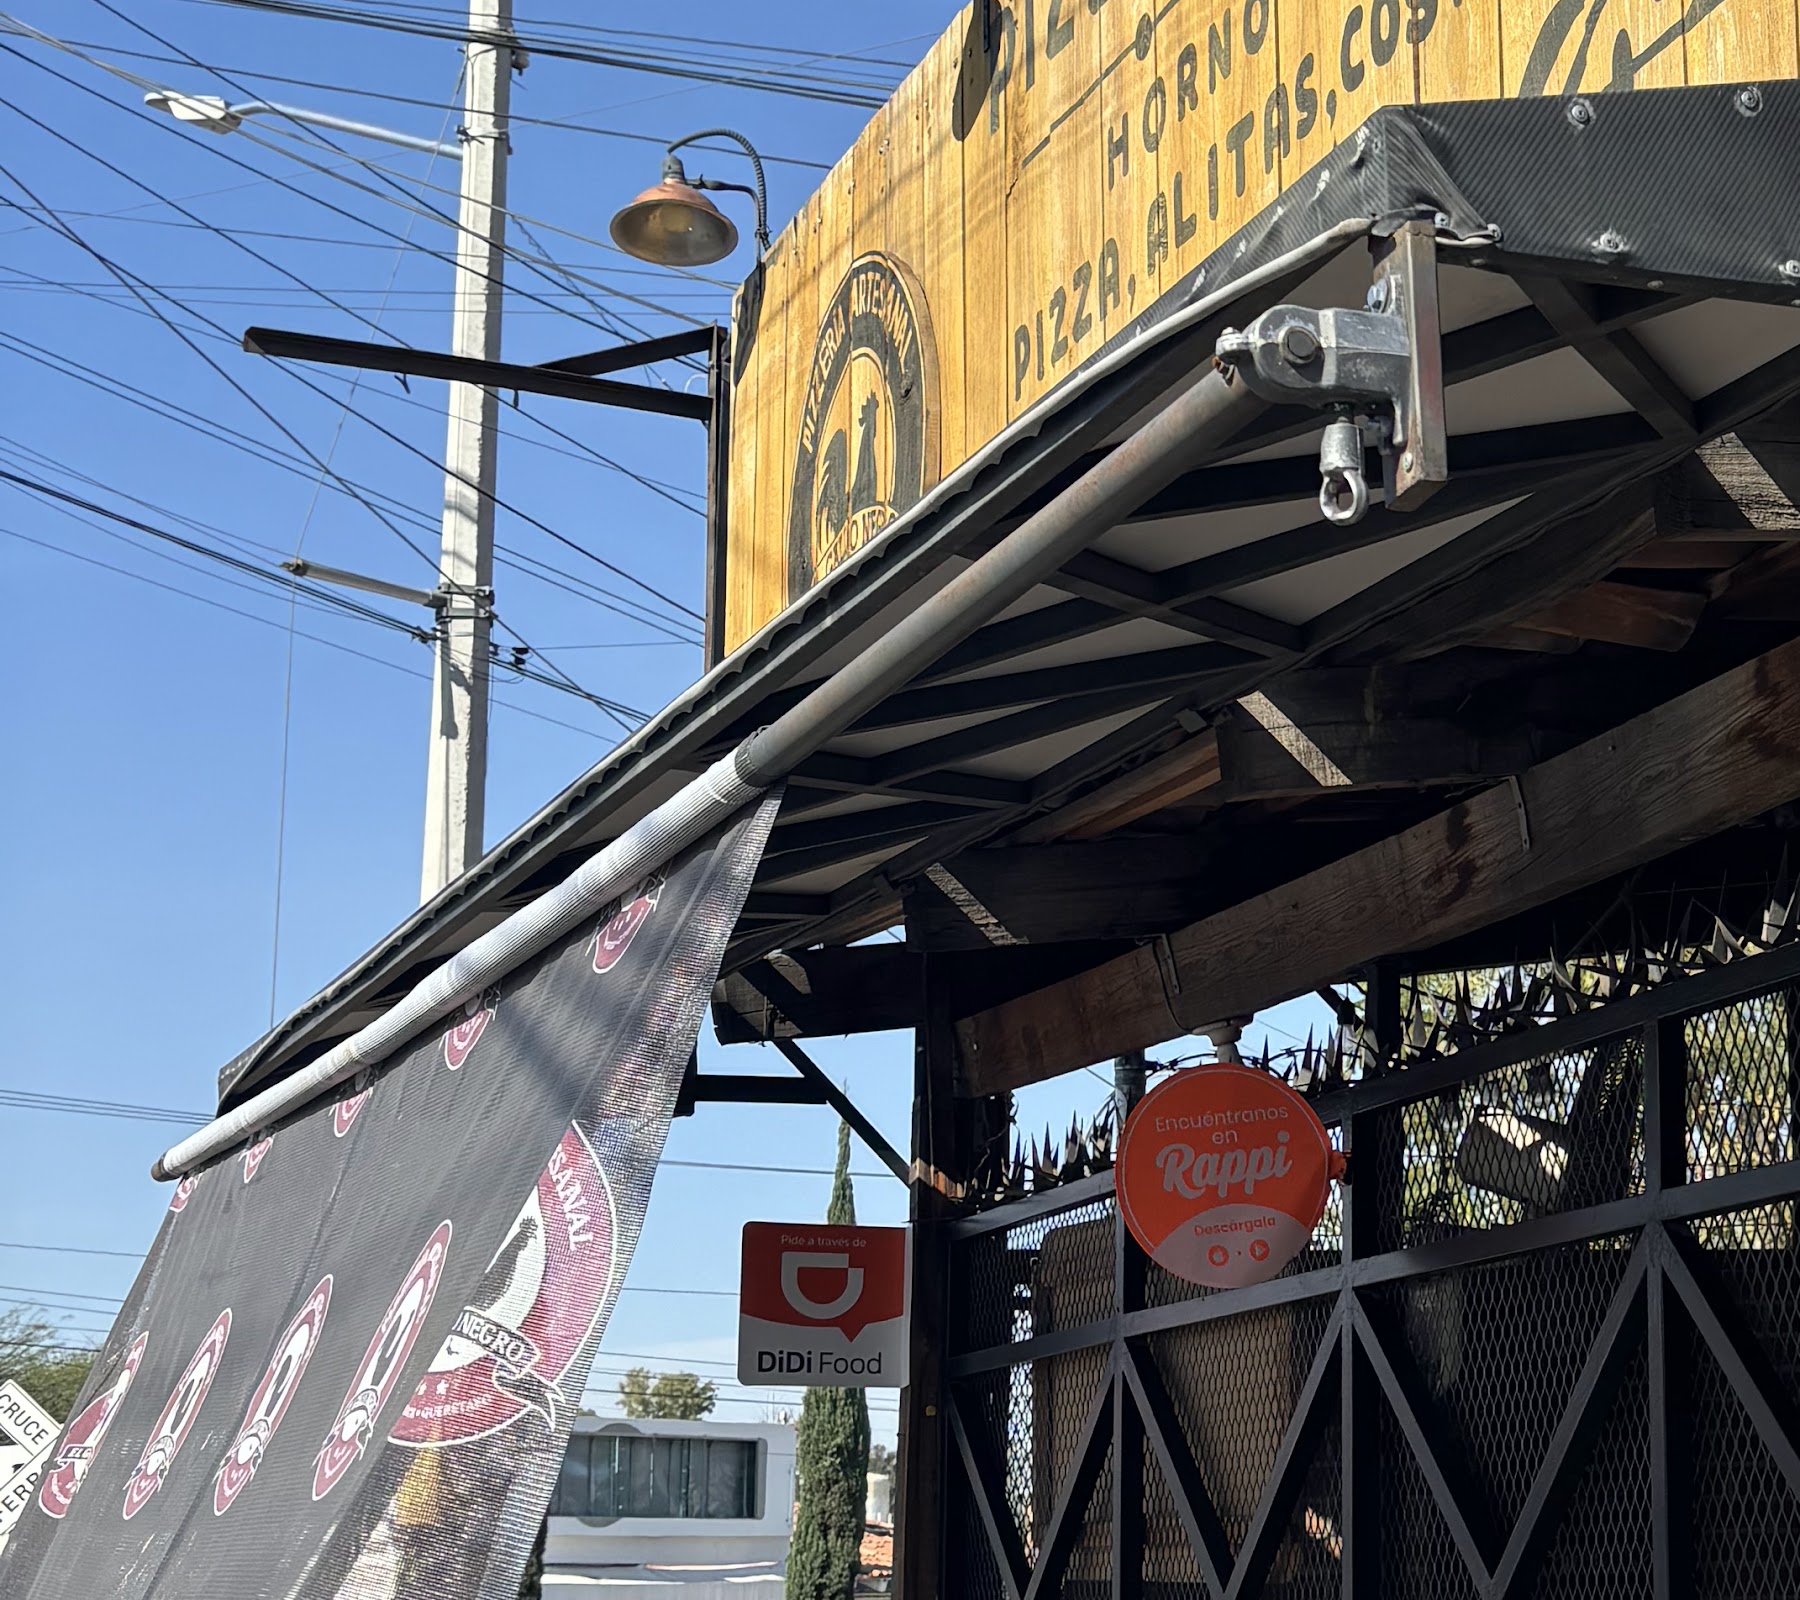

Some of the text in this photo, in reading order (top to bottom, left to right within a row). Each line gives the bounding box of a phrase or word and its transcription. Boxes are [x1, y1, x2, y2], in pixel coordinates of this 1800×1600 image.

[1155, 1105, 1288, 1132] Encuéntranos
[1211, 1130, 1238, 1145] en
[1156, 1130, 1293, 1200] Rappi
[1194, 1216, 1276, 1237] Descárgala
[781, 1235, 804, 1245] Pide
[852, 1236, 867, 1248] de
[457, 1312, 524, 1362] NEGRO
[758, 1350, 882, 1374] DiDi Food
